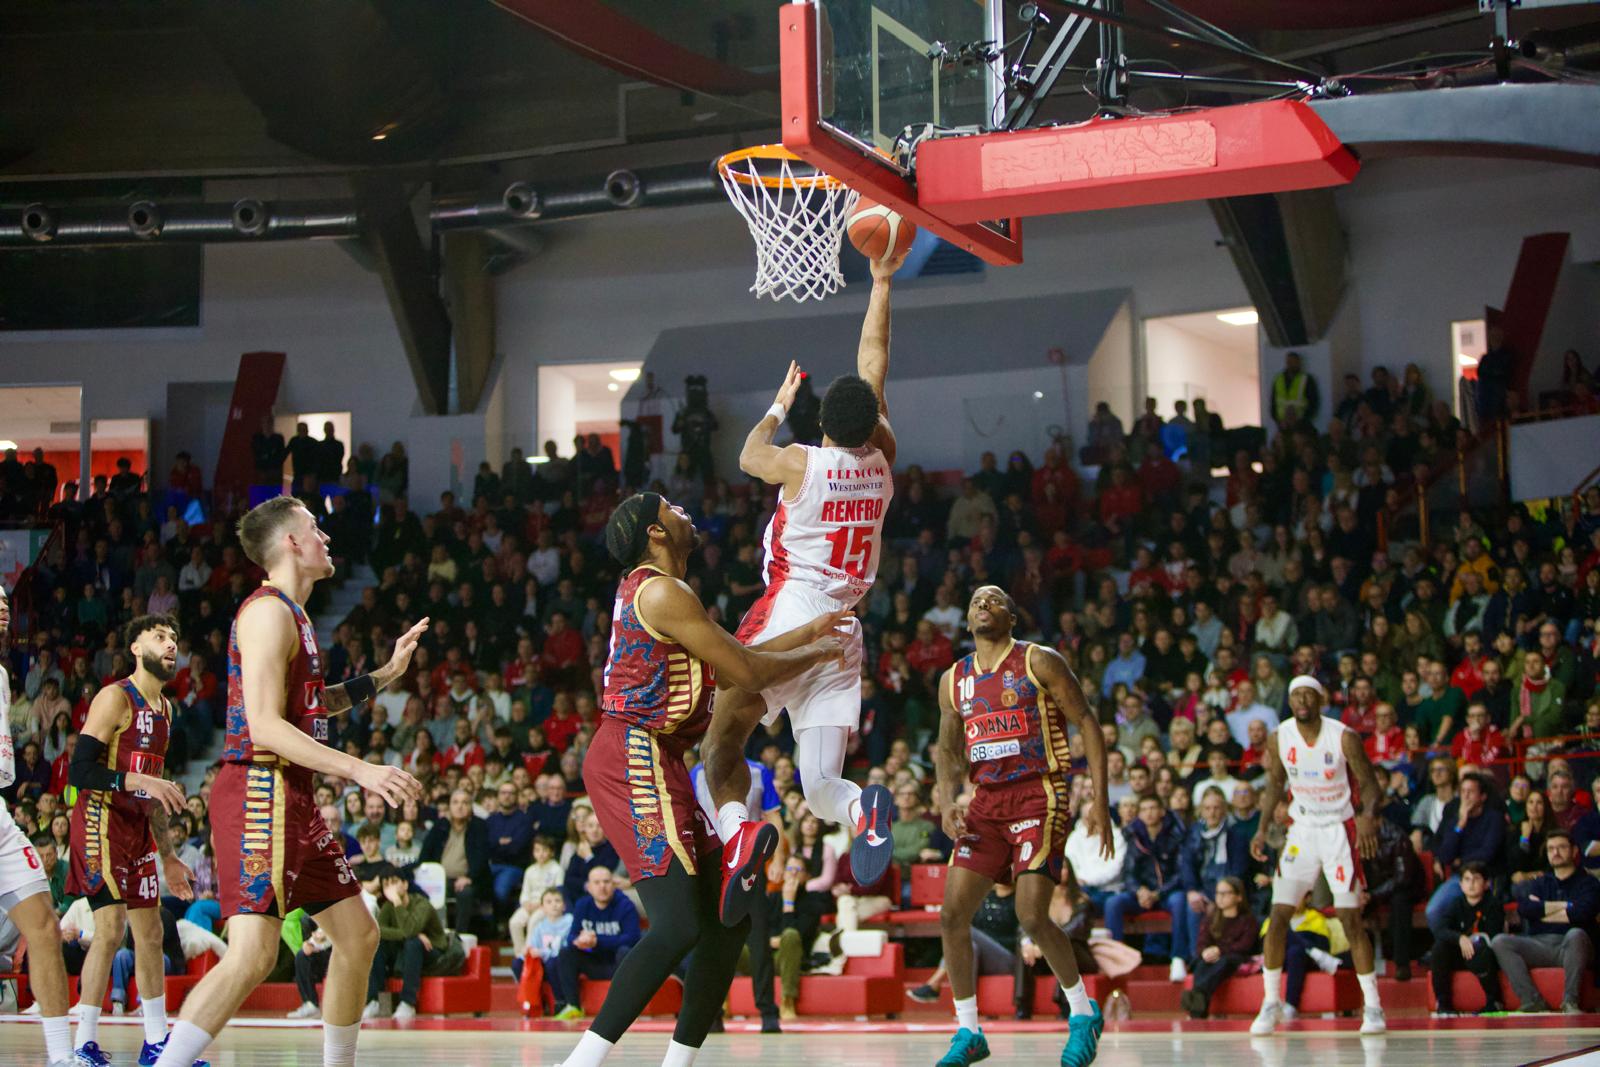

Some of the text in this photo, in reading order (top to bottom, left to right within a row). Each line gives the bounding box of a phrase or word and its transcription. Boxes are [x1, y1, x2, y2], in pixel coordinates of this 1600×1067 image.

[821, 498, 883, 522] RENFRO
[825, 526, 874, 580] 15
[957, 675, 975, 702] 10
[136, 710, 153, 734] 45
[1287, 747, 1297, 766] 4
[1335, 864, 1345, 882] 4
[138, 875, 158, 900] 45
